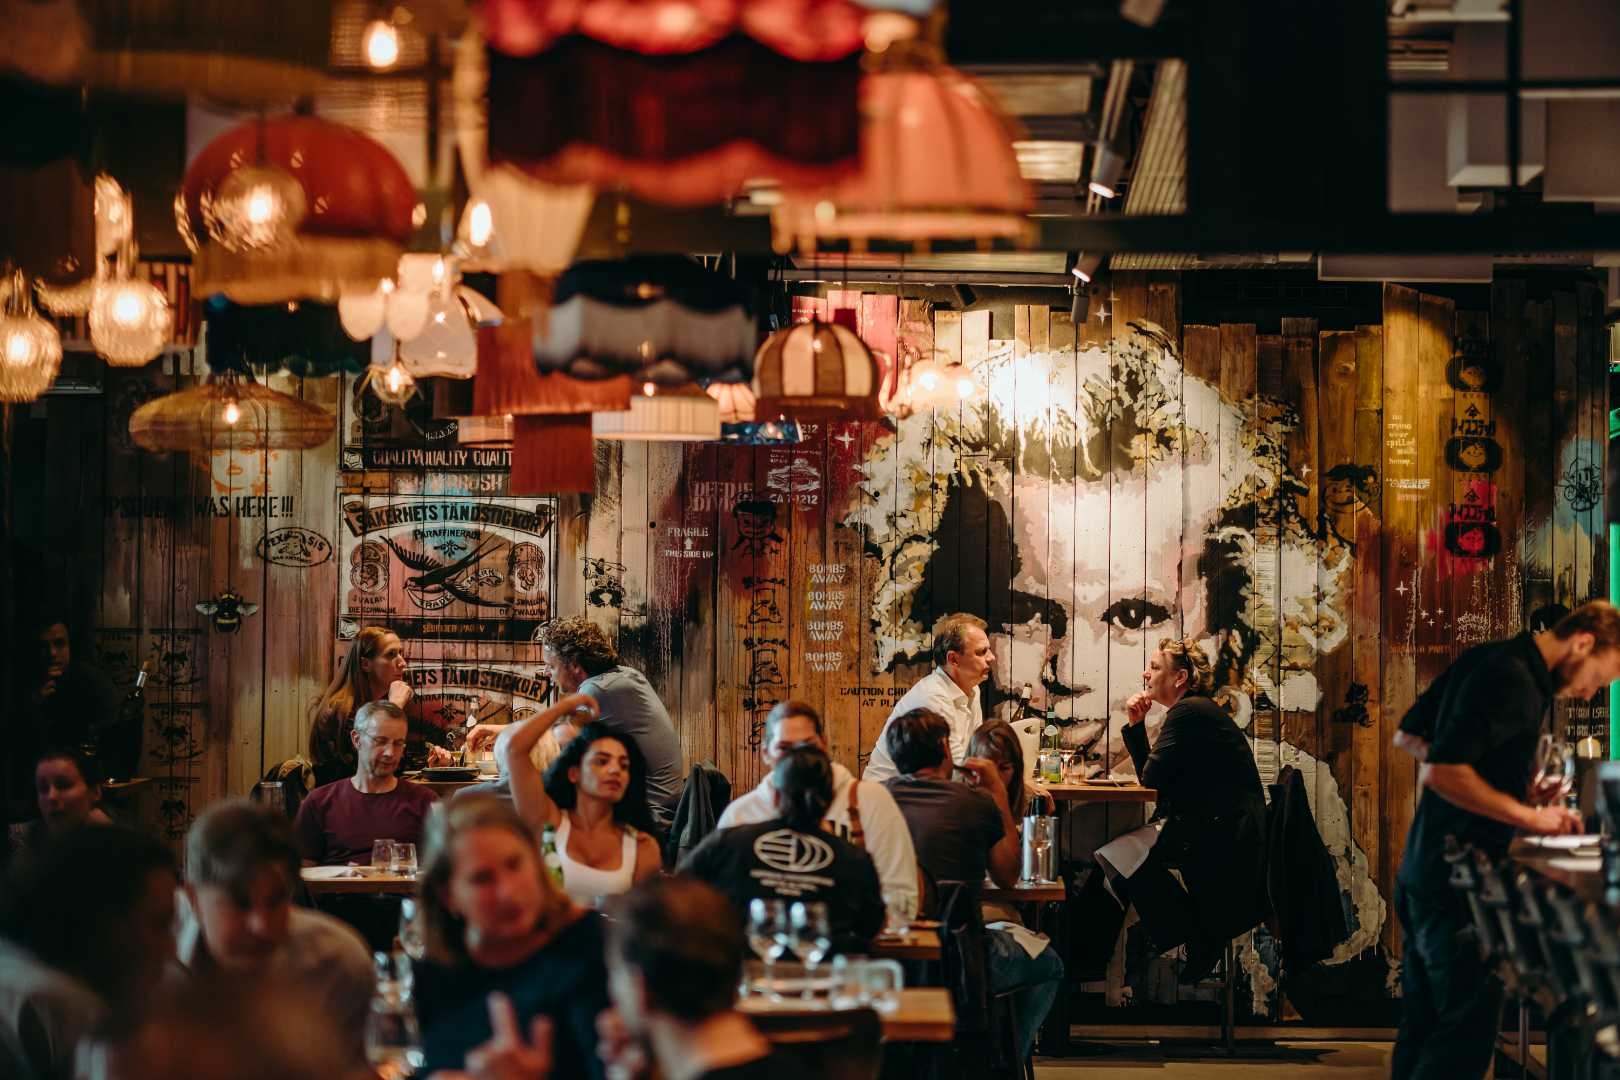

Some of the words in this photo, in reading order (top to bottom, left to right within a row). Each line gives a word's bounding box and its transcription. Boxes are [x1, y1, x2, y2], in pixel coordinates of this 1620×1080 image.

[474, 450, 512, 466] QUALIT
[667, 527, 709, 537] FRAGILE
[840, 688, 884, 696] CAUTION
[862, 699, 876, 707] AT
